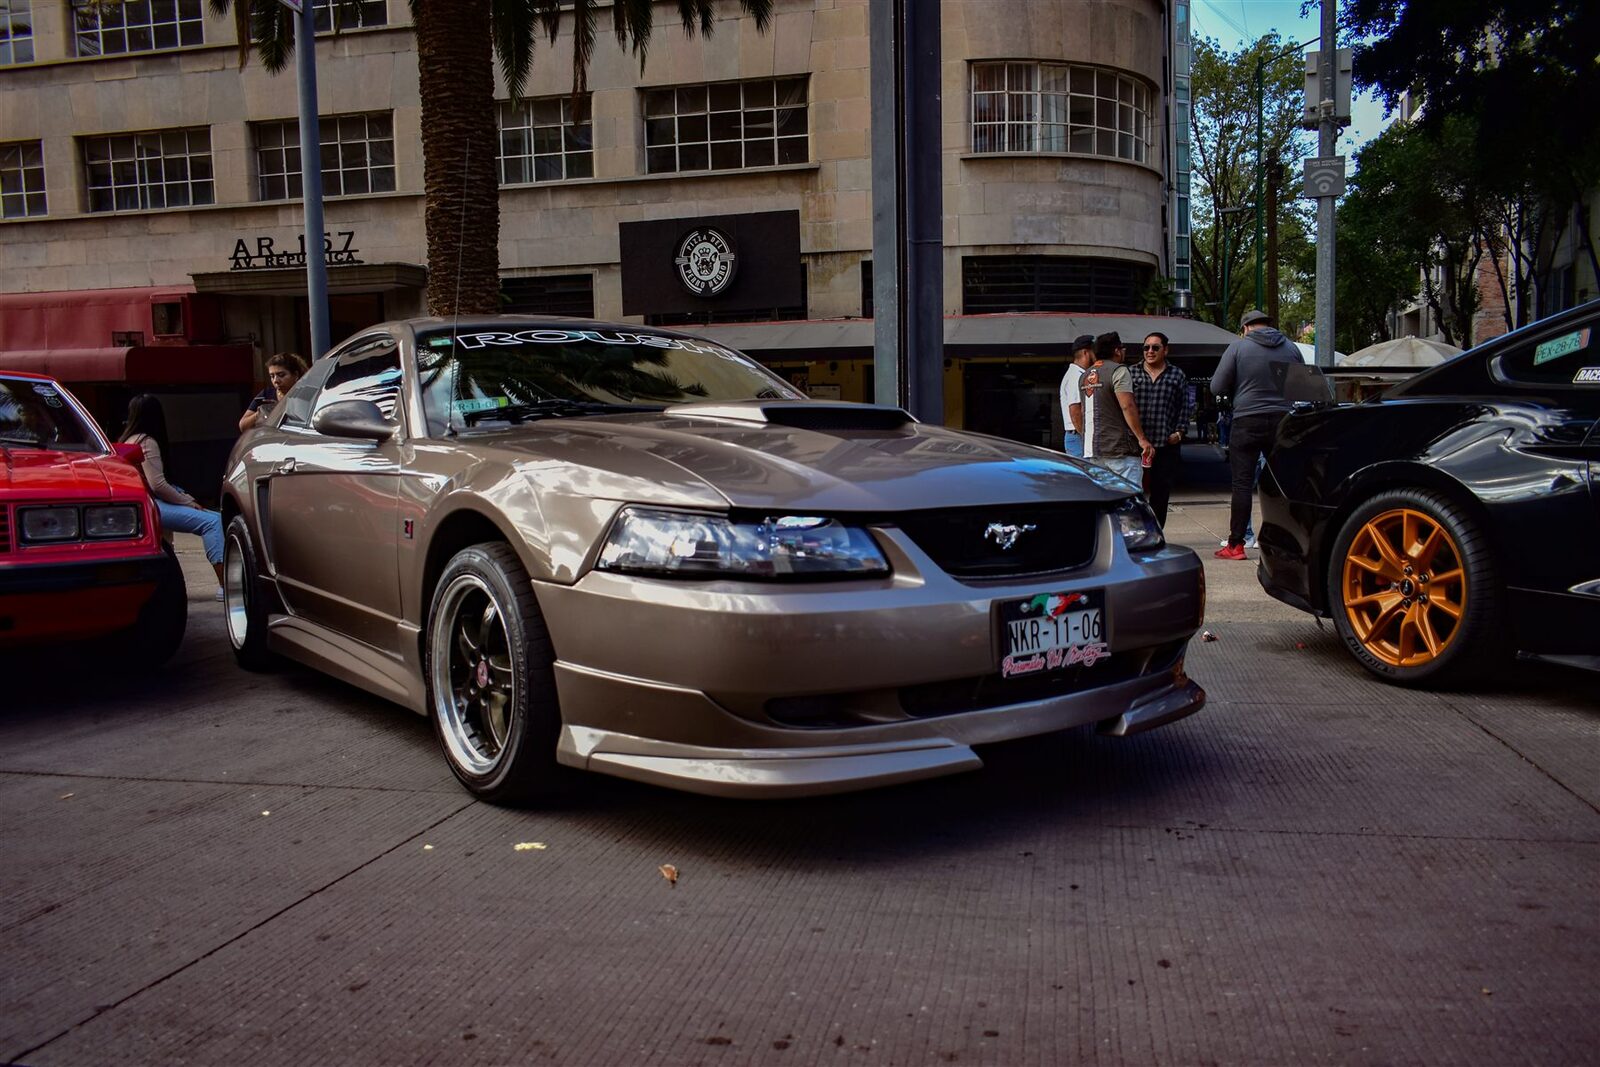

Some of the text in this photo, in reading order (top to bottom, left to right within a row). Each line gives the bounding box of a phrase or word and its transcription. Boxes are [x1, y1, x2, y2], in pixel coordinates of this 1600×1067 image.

[686, 234, 723, 251] PIZZA DEL
[264, 251, 357, 268] REPUICA
[685, 265, 727, 289] PERRO NEGRO
[1008, 611, 1101, 653] NKR-11-06
